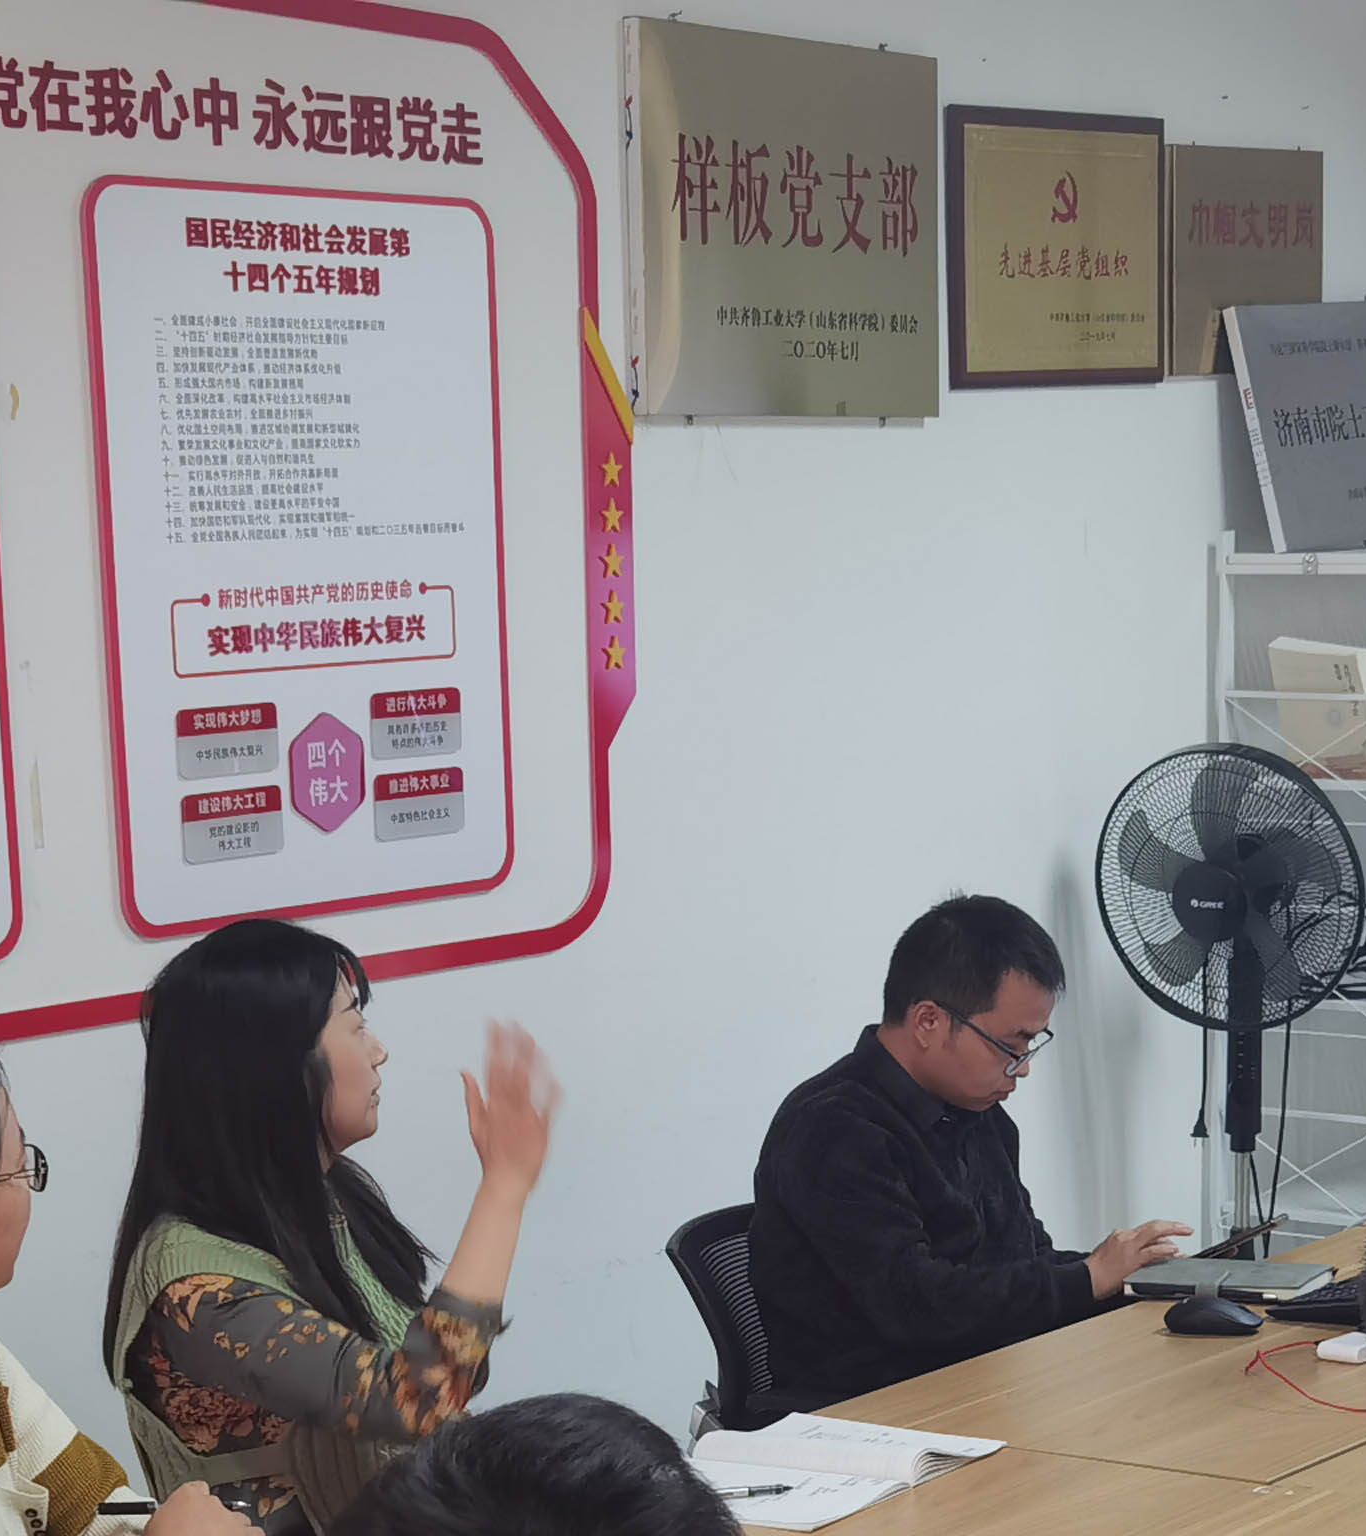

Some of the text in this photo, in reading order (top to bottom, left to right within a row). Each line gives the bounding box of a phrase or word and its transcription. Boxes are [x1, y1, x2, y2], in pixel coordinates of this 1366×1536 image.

[253, 79, 484, 165] 永远跟党走
[670, 132, 920, 258] 样板党支部
[186, 216, 411, 257] 国民经济和社会发展第
[1187, 199, 1316, 249] 巾帼文明岗
[223, 261, 380, 297] 十四个五年规划
[998, 242, 1130, 281] 先进基层党组织
[218, 579, 412, 610] 新时代中国共产党的历史使命
[207, 614, 426, 657] 实现中华民族伟大复兴
[307, 740, 346, 770] 四个
[309, 779, 348, 807] 伟大
